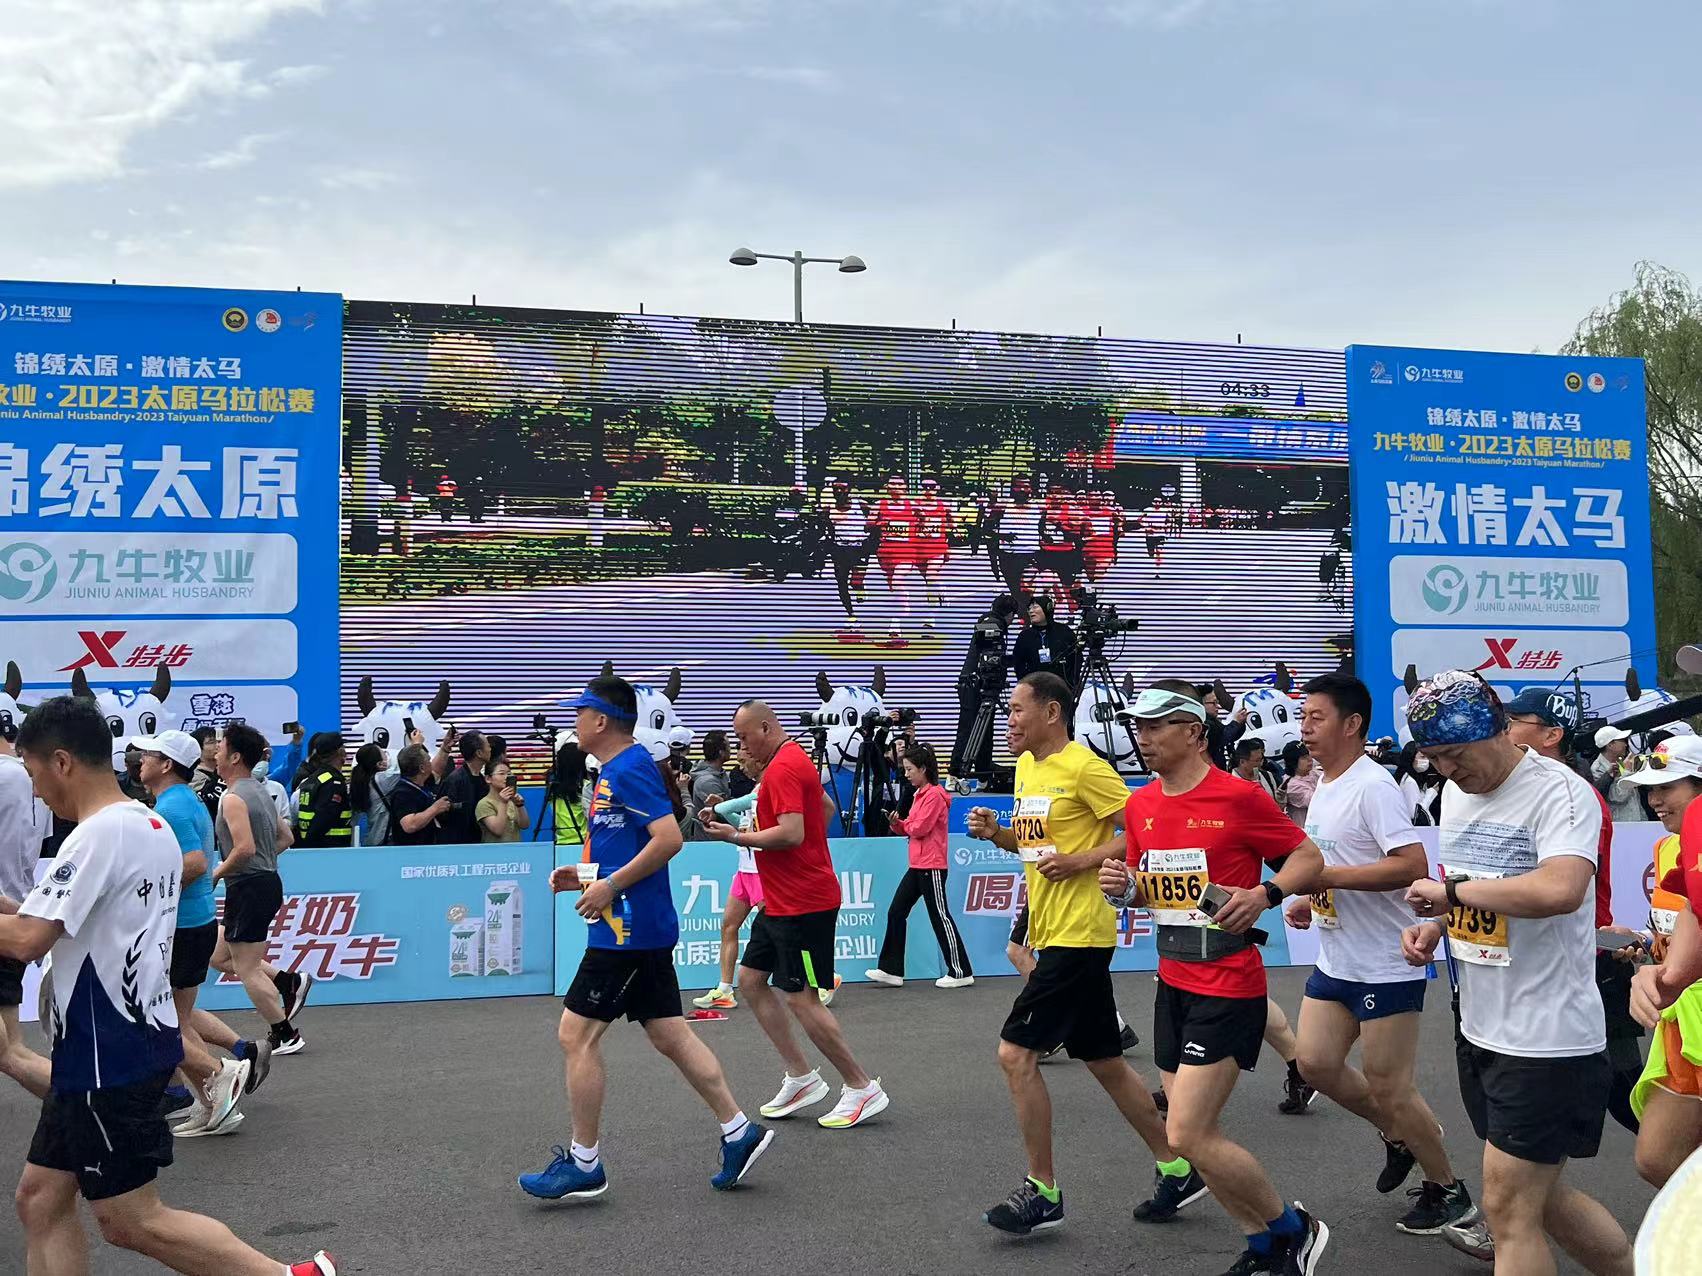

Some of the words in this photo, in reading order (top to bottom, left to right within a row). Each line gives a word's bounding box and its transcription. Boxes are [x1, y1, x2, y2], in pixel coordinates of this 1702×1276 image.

[10, 304, 72, 318] 九牛牧业
[1421, 367, 1464, 379] 九牛牧业
[1220, 382, 1271, 398] 04:33
[23, 410, 64, 420] Animal
[167, 412, 210, 424] Taiyuan
[1436, 455, 1464, 464] Animal
[1533, 459, 1562, 469] Taiyuan
[1386, 481, 1626, 549] 激情太马
[68, 548, 256, 584] 九牛牧业
[65, 588, 111, 600] JIUNIU
[115, 587, 168, 599] ANIMAL
[172, 586, 256, 599] HUSBANDRY
[1475, 570, 1600, 601] 九牛牧业
[1474, 602, 1505, 612] JIUNIU
[1508, 602, 1543, 612] ANIMAL
[1546, 603, 1600, 613] HUSBANDRY
[190, 693, 235, 716] 雪花
[1012, 818, 1045, 841] 13720
[401, 862, 531, 878] 国家优质乳工程示范企业
[1141, 875, 1202, 901] 11856
[680, 918, 722, 932] JIUNI
